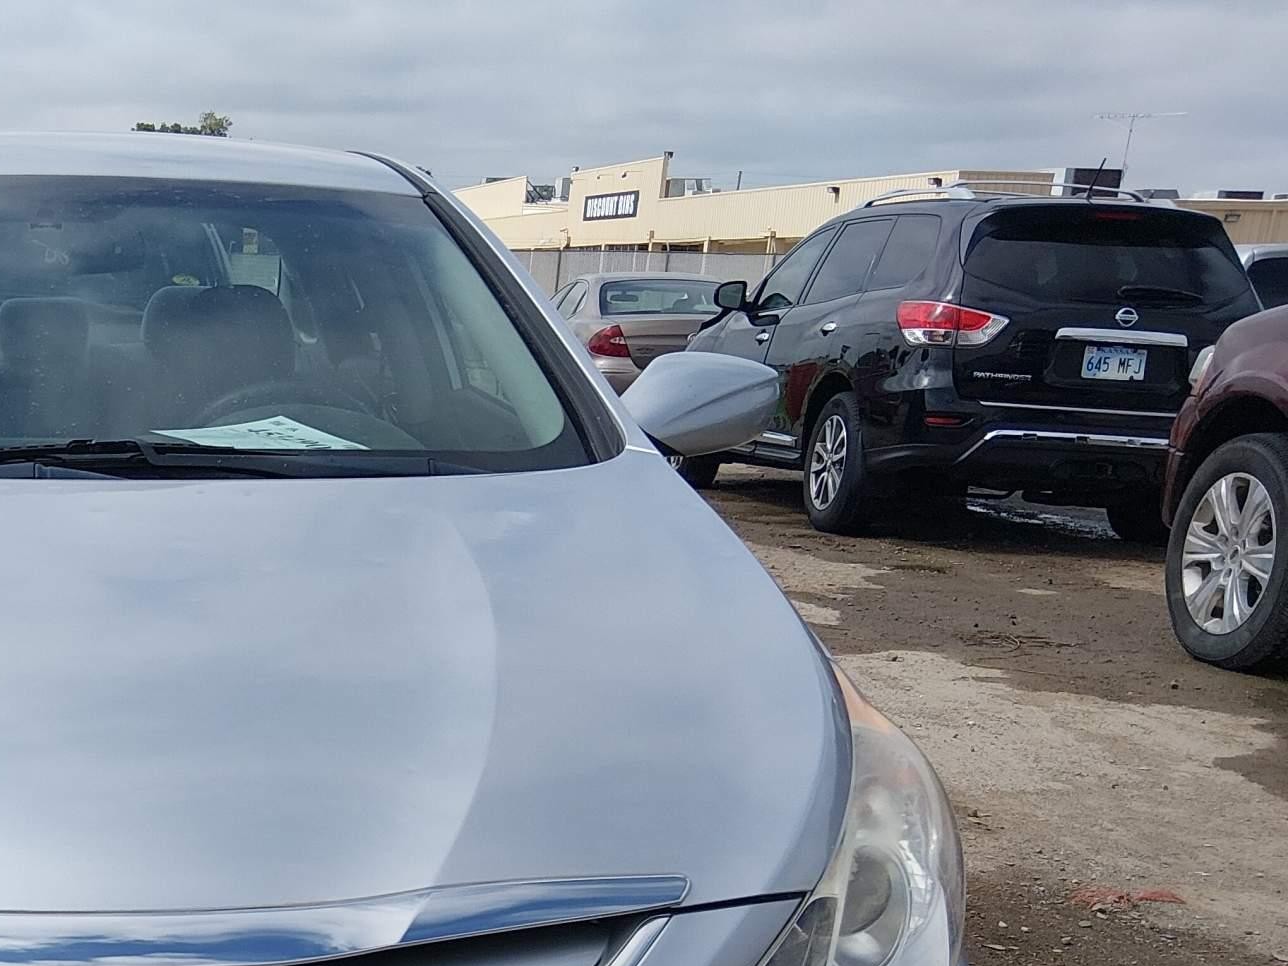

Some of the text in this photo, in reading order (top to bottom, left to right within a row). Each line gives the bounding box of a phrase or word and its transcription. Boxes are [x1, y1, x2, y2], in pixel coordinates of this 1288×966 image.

[586, 196, 618, 217] DISCOUNT
[1086, 355, 1142, 374] 645 MFJ
[973, 371, 1032, 381] PATHFINDER
